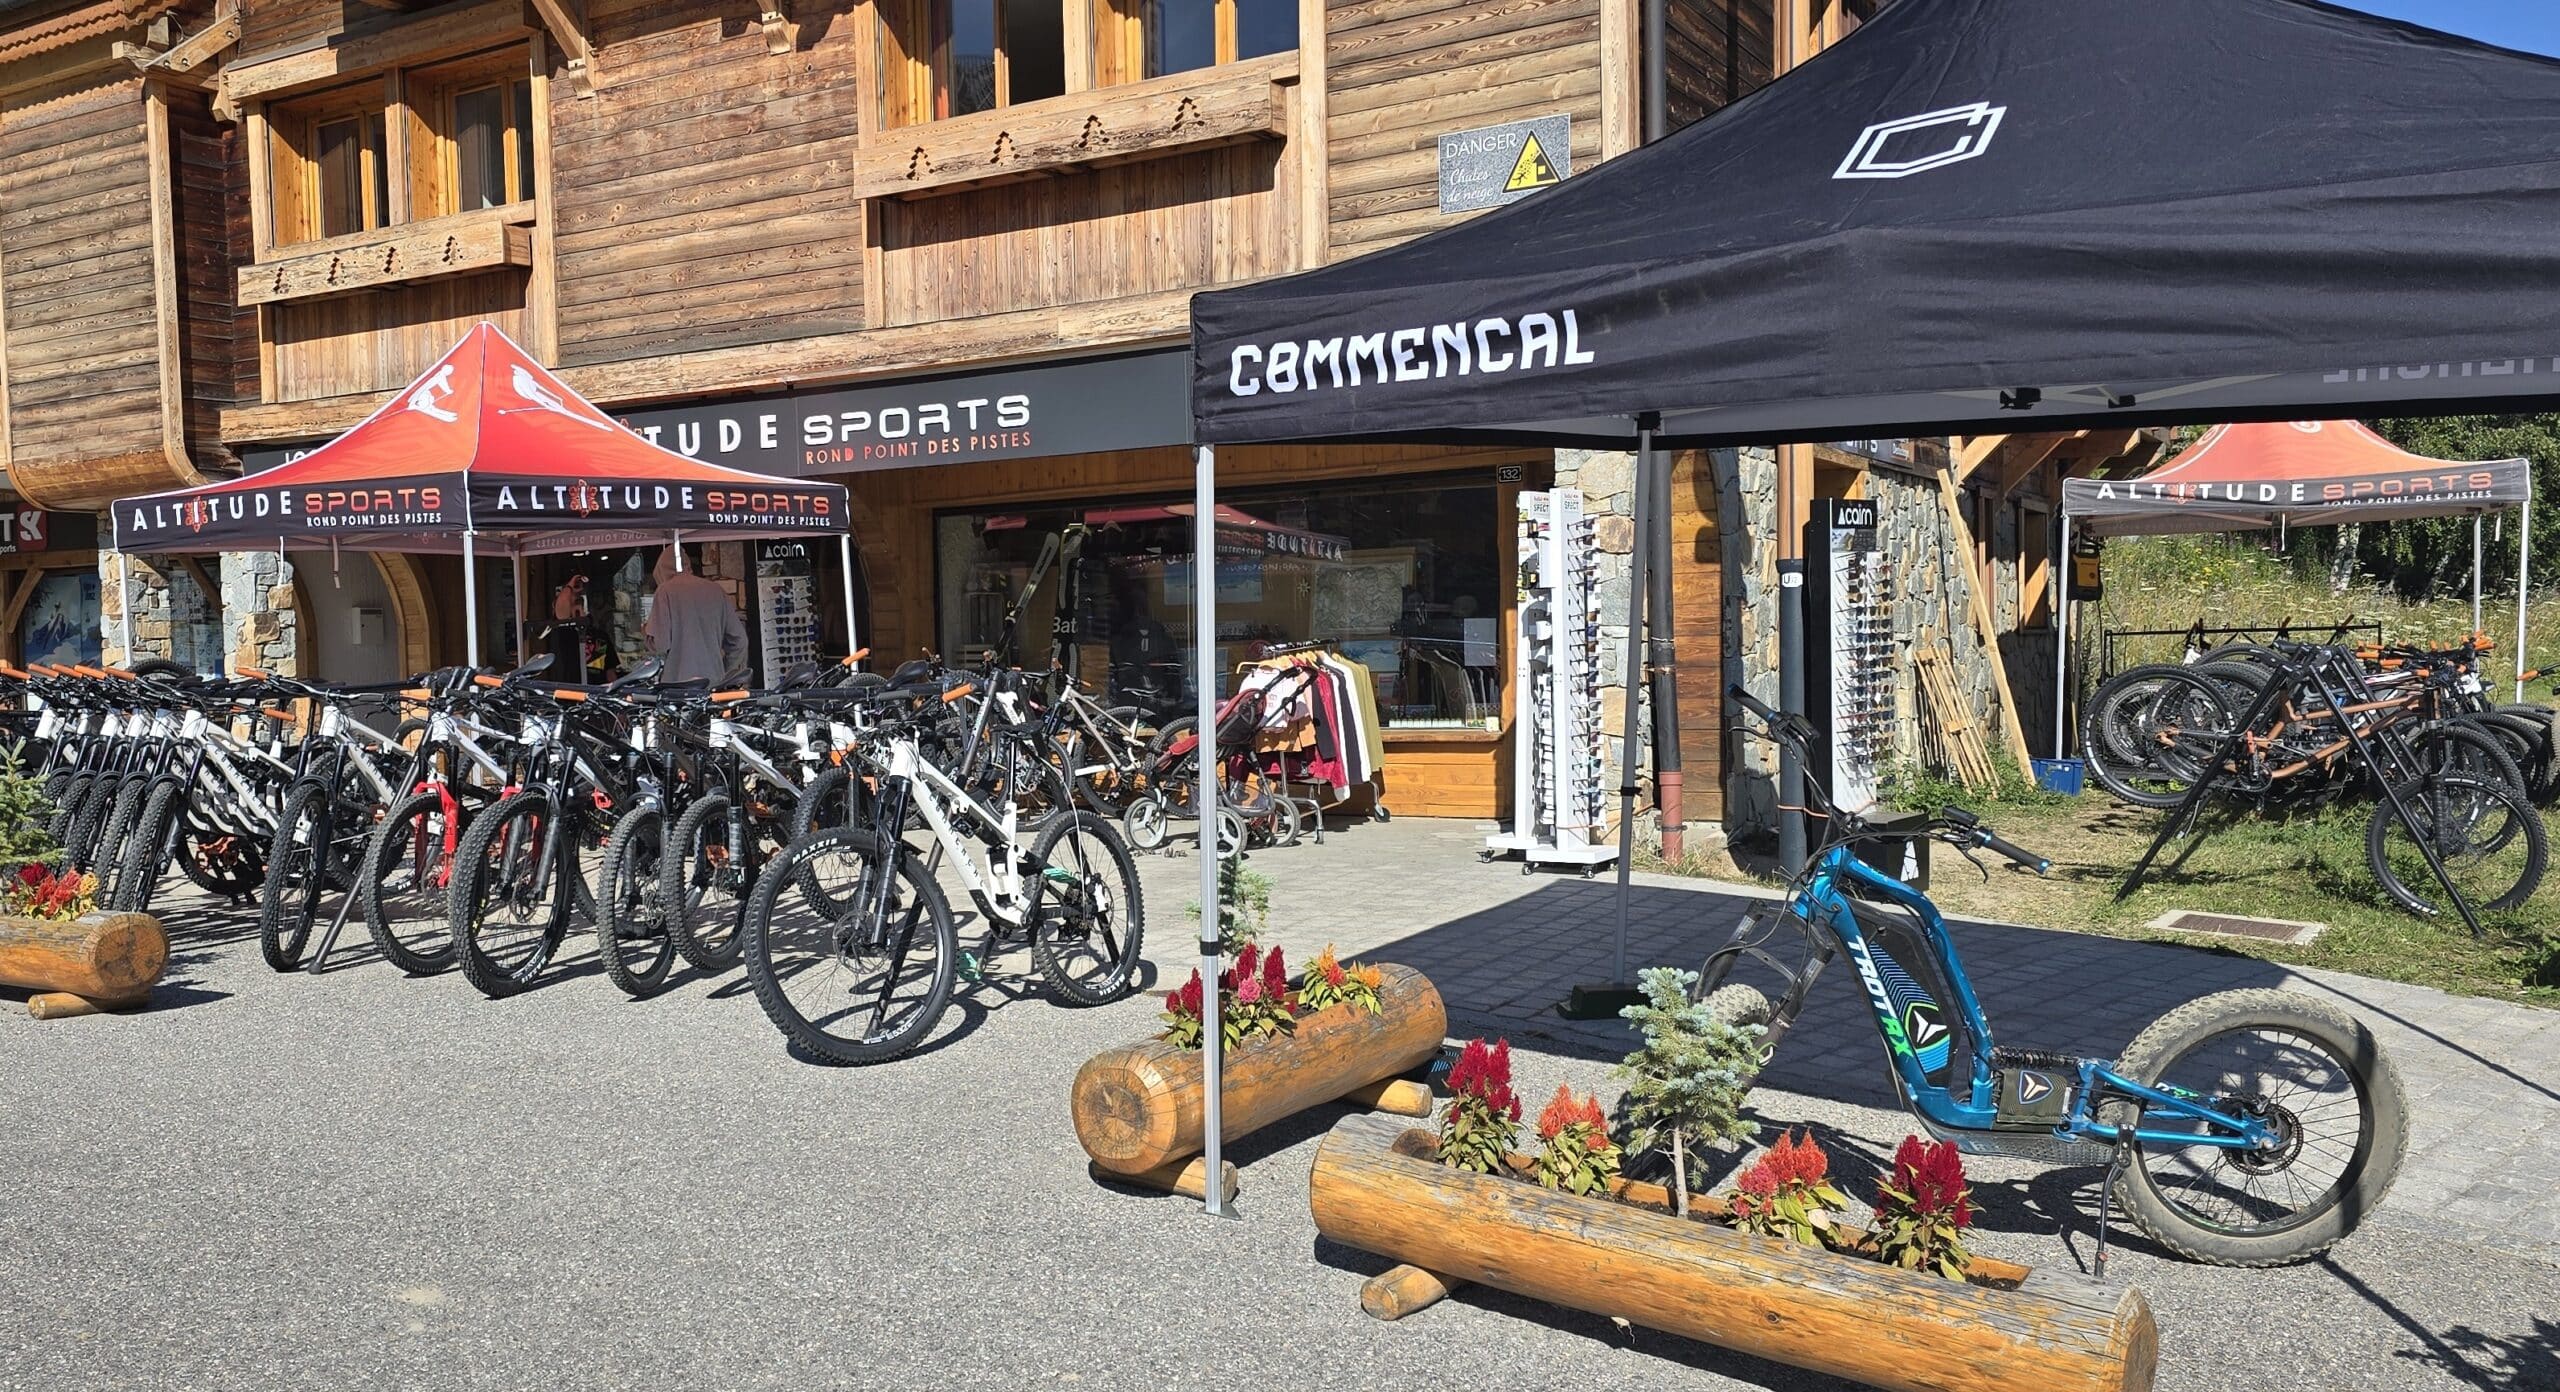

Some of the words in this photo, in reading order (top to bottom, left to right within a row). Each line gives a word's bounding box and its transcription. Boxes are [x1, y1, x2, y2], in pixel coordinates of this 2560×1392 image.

[1446, 133, 1518, 158] DANGER
[1462, 187, 1495, 201] neige
[1229, 308, 1596, 397] COMMENCAL
[803, 394, 1031, 446] SPORTS
[806, 447, 855, 466] ROND
[864, 442, 919, 460] POINT
[928, 438, 960, 456] DES
[970, 432, 1031, 451] PISTES
[1502, 468, 1519, 480] 132
[2097, 481, 2306, 501] ALTITUDE
[2322, 472, 2493, 500] SPORTS
[497, 485, 694, 510] ALTITUDE
[707, 491, 830, 515] SPORTS
[2415, 492, 2441, 503] DES
[2447, 489, 2493, 500] PISTES
[132, 490, 293, 532] ALTITUDE
[305, 487, 441, 514] SPORTS
[306, 515, 337, 527] ROND
[341, 513, 375, 526] POINT
[379, 512, 401, 525] DES
[405, 512, 442, 524] PISTES
[709, 513, 739, 524] ROND
[743, 514, 774, 525] POINT
[778, 515, 796, 526] DES
[799, 515, 831, 527] PISTES
[1845, 503, 1873, 525] cairn
[772, 541, 805, 558] cairn
[792, 837, 838, 865] MAXXIS
